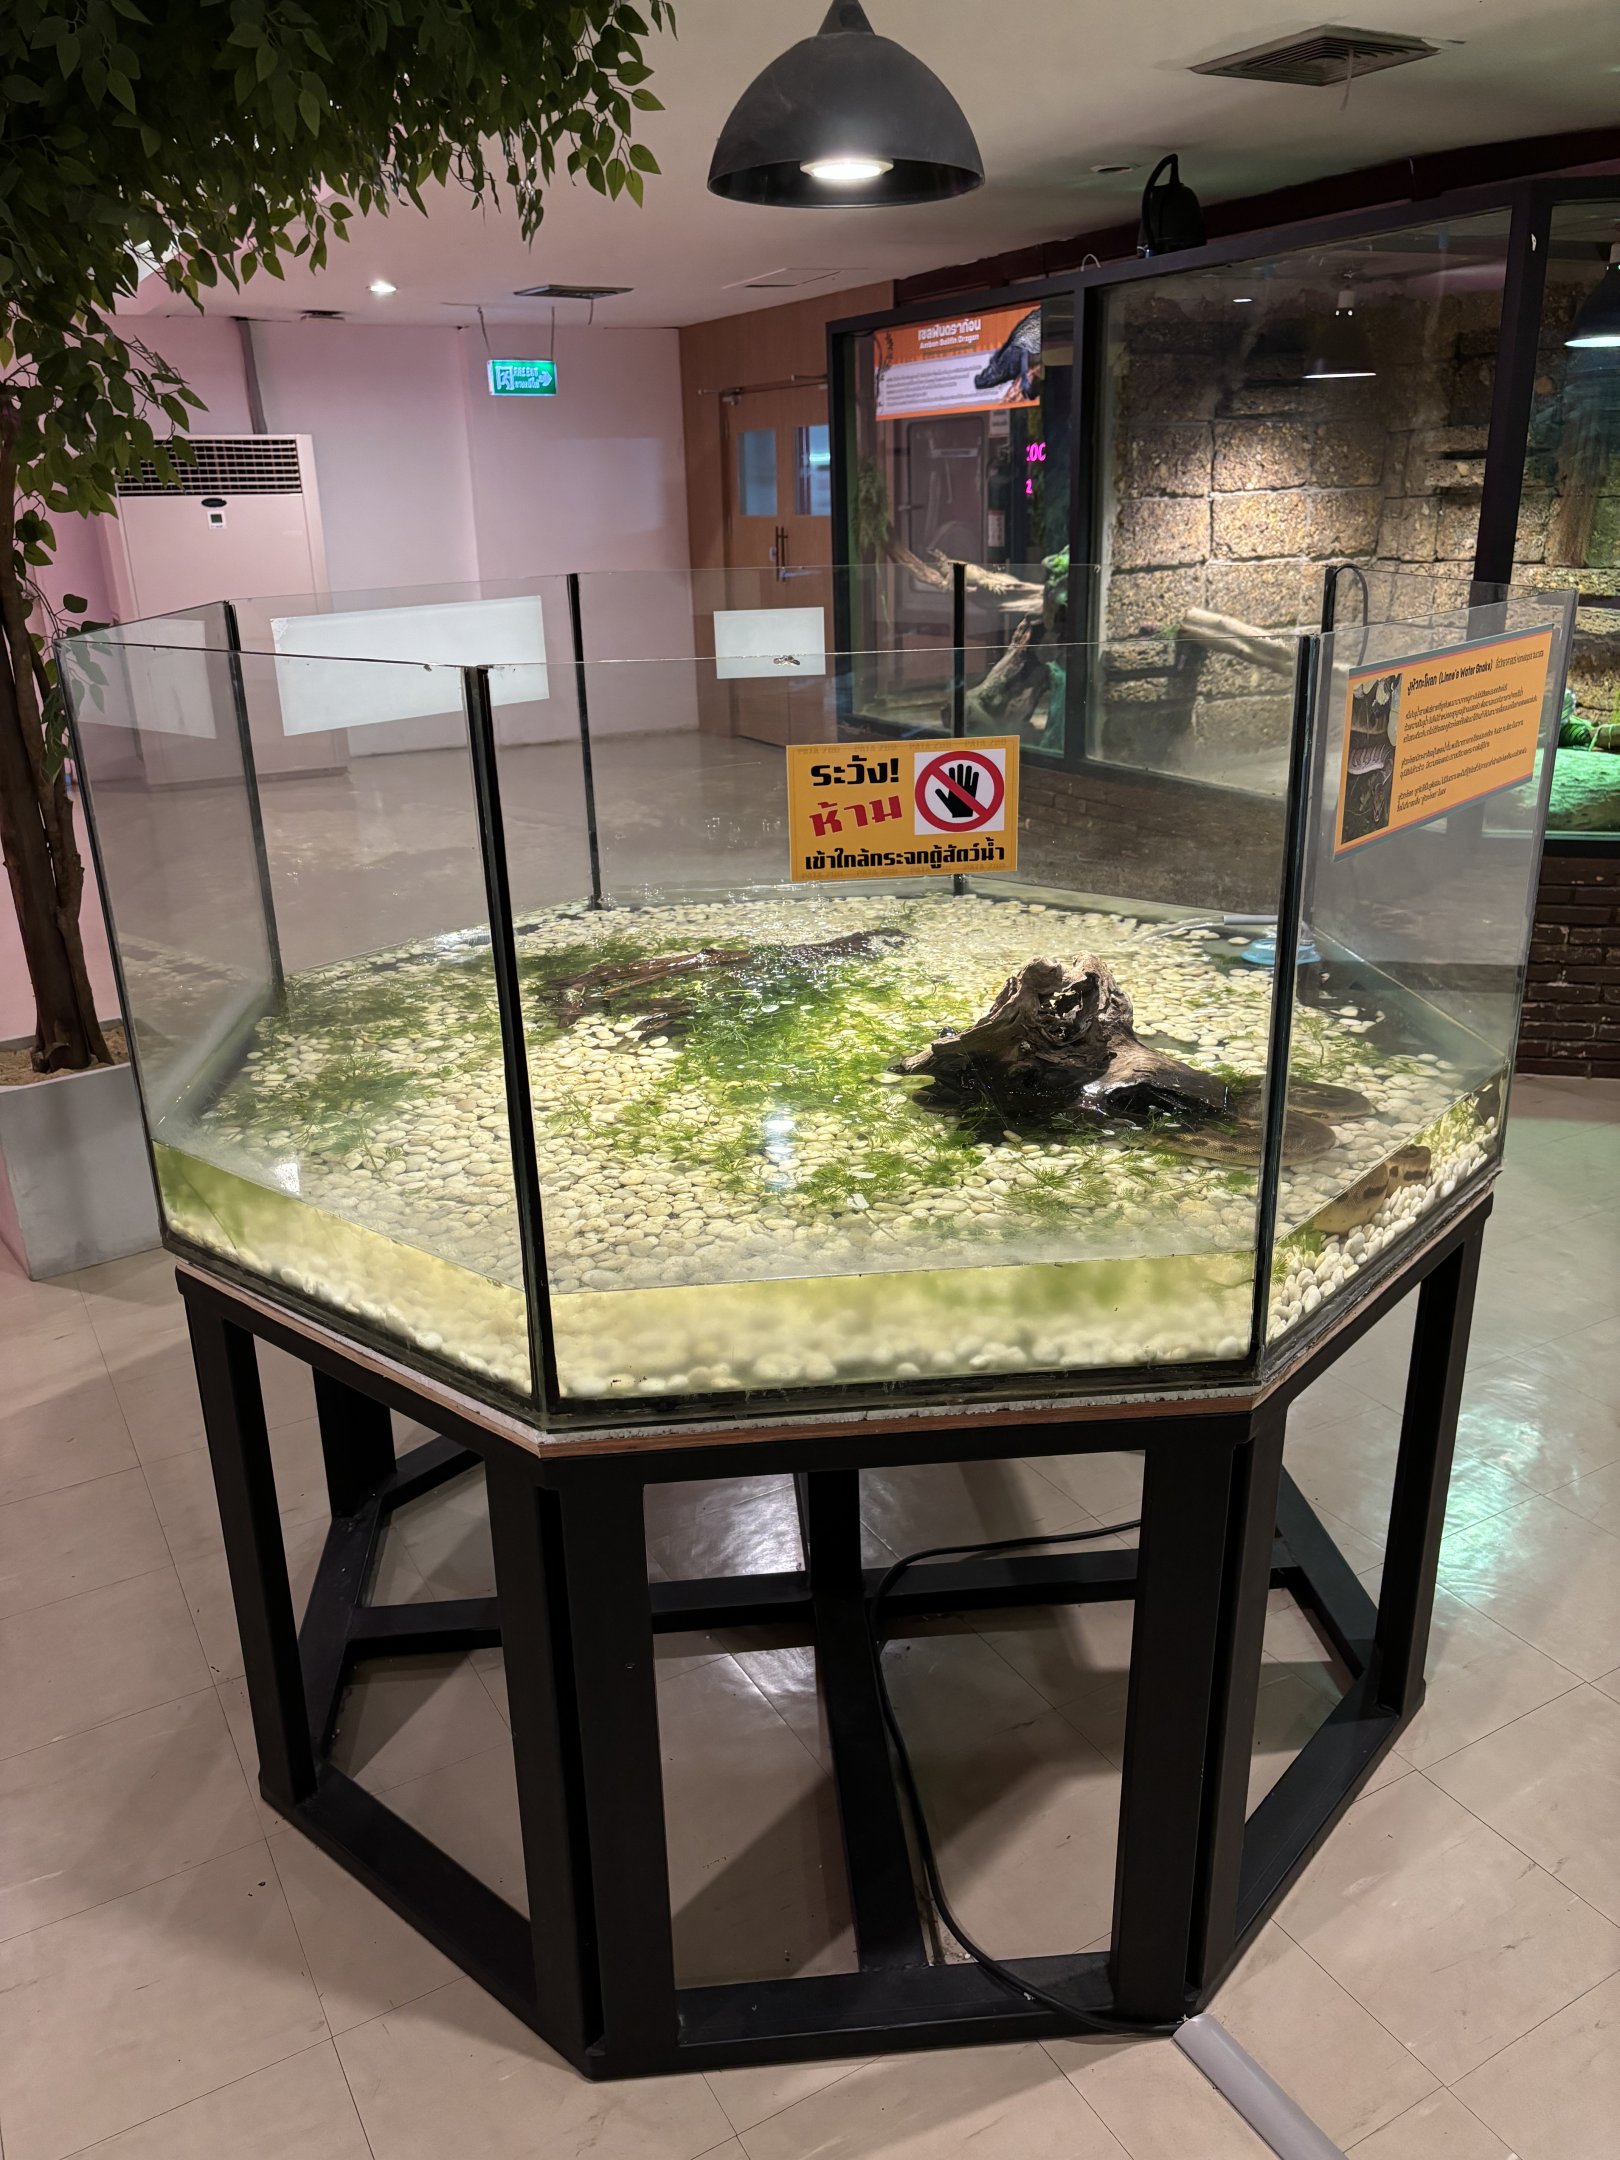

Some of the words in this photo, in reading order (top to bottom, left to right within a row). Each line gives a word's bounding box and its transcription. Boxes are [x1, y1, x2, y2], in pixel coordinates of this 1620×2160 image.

[957, 333, 980, 344] Dragon
[1460, 665, 1476, 678] Water
[1476, 659, 1493, 674] Snake)
[810, 754, 900, 787] ระวัง!
[809, 795, 903, 837] ห้าม
[805, 837, 1005, 870] เข้าใกล้กระจกตู้สัตว์น้ำ
